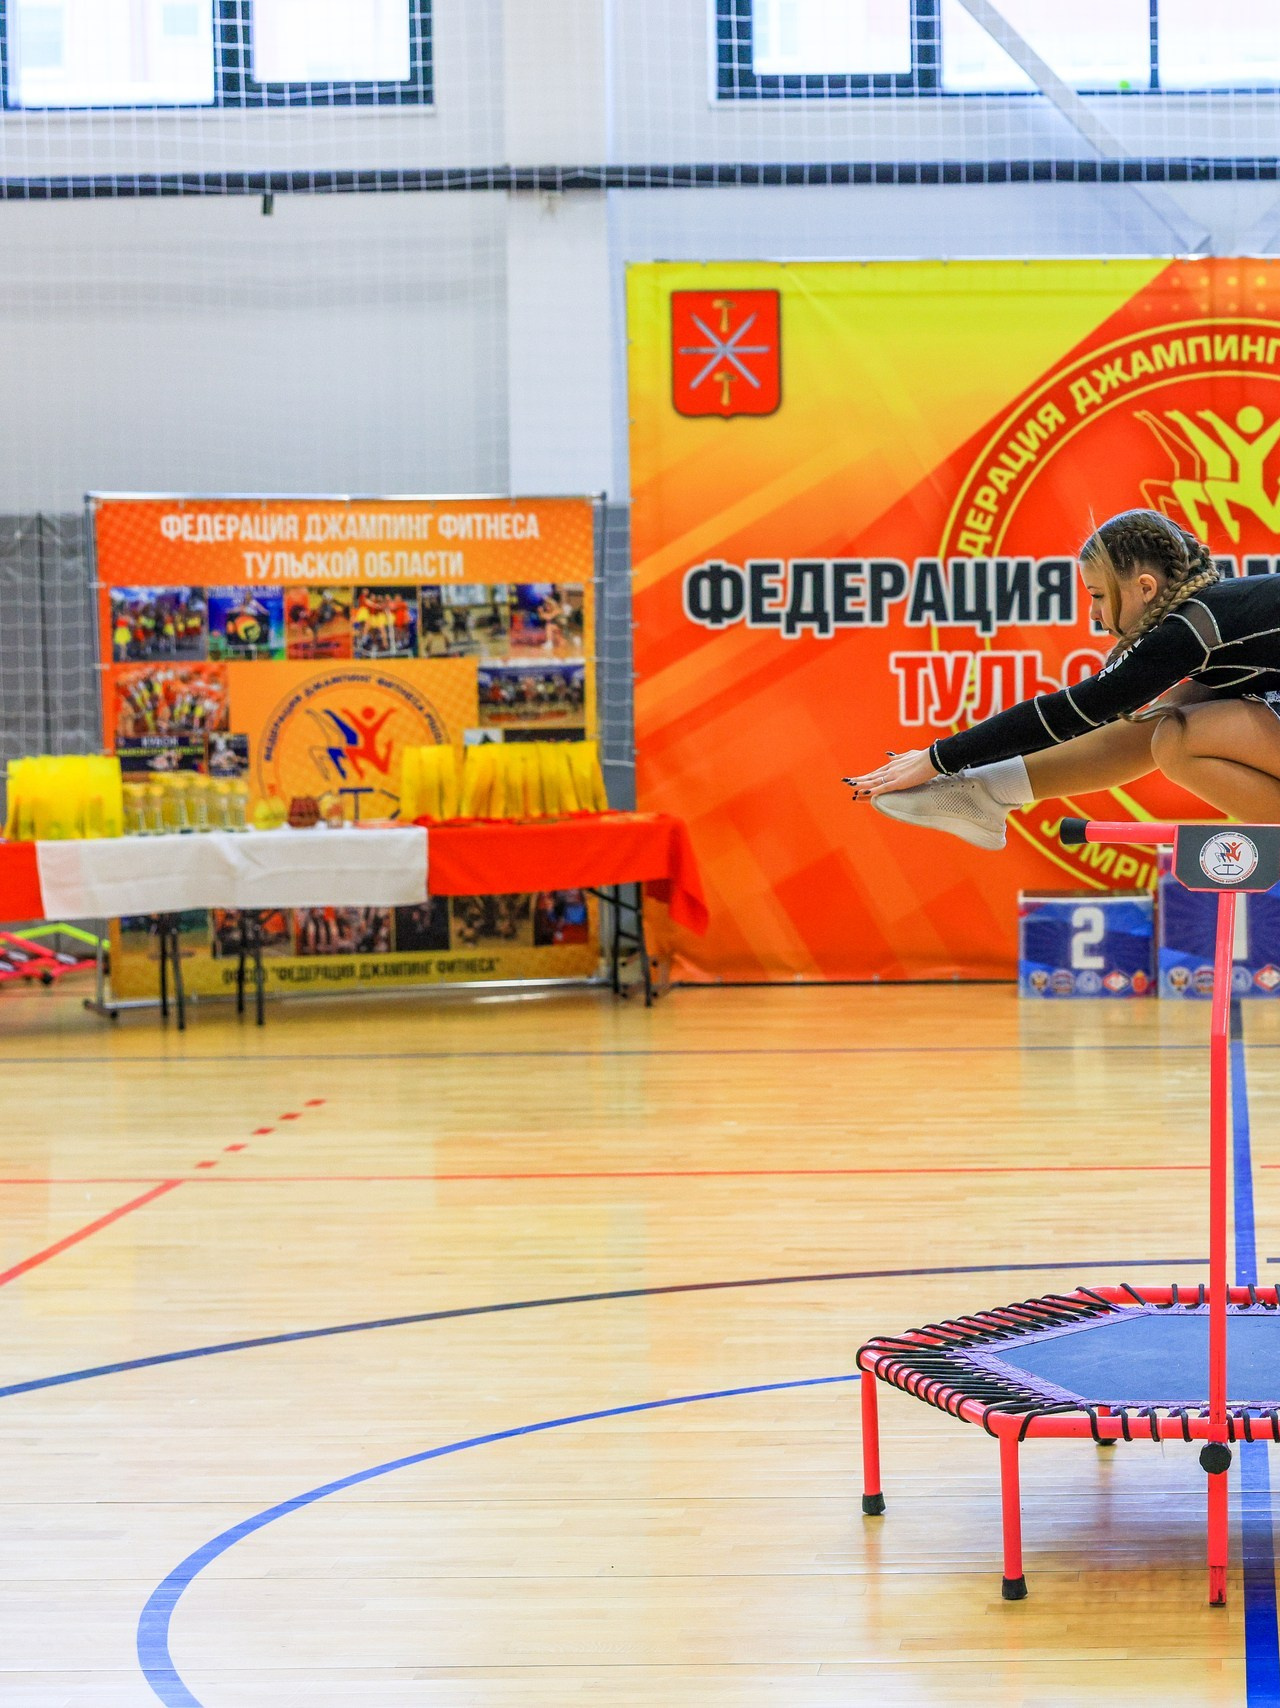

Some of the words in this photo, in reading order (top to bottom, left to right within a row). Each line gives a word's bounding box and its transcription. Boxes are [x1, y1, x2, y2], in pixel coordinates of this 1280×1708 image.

[956, 401, 1067, 558] ДЕРАЦИЯ
[160, 513, 299, 543] ФЕДЕРАЦИЯ
[303, 512, 433, 542] ДЖАМПИНГ
[437, 512, 540, 540] ФИТНЕСА
[243, 549, 361, 580] ТУЛЬСКОЙ
[364, 550, 465, 578] ОБЛАСТИ
[685, 559, 1076, 637] ФЕДЕРАЦИЯ
[1071, 906, 1105, 969] 2
